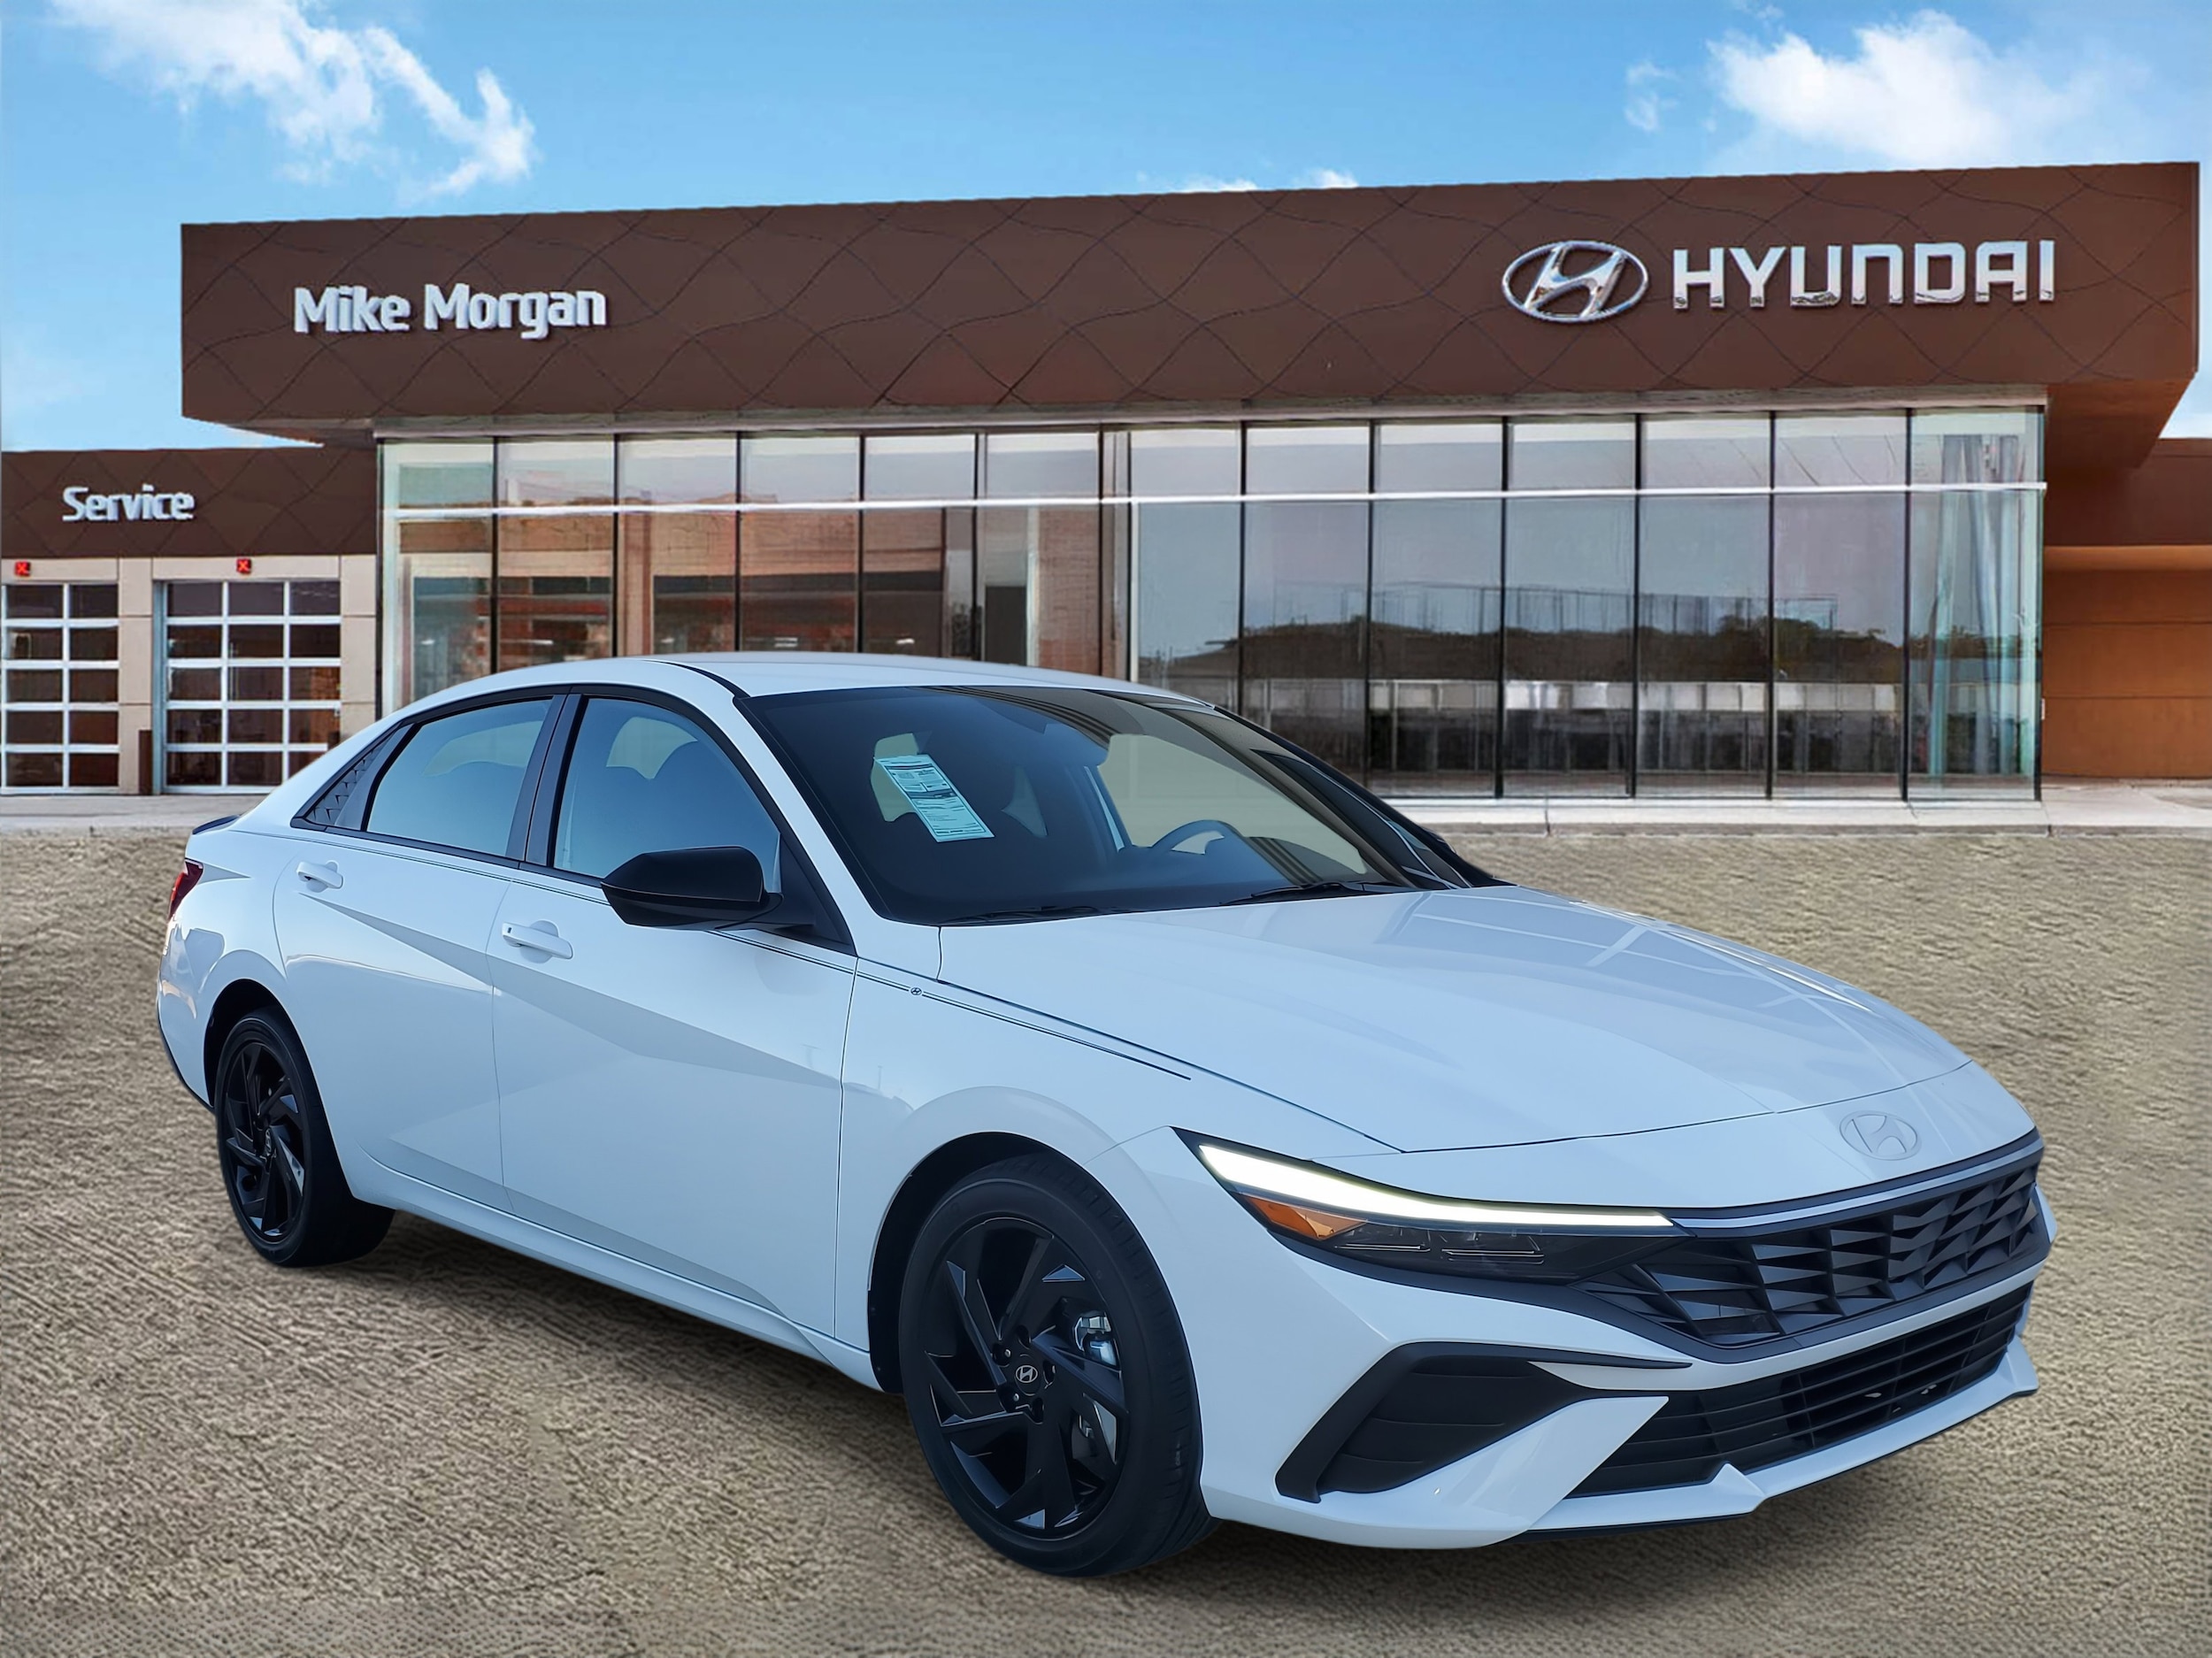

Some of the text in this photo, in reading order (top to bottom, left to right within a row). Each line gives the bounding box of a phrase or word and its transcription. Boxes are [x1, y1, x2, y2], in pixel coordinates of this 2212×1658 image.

[1673, 239, 2055, 310] HYUNDAI
[294, 282, 606, 340] Mike Morgan
[62, 483, 194, 522] Service
